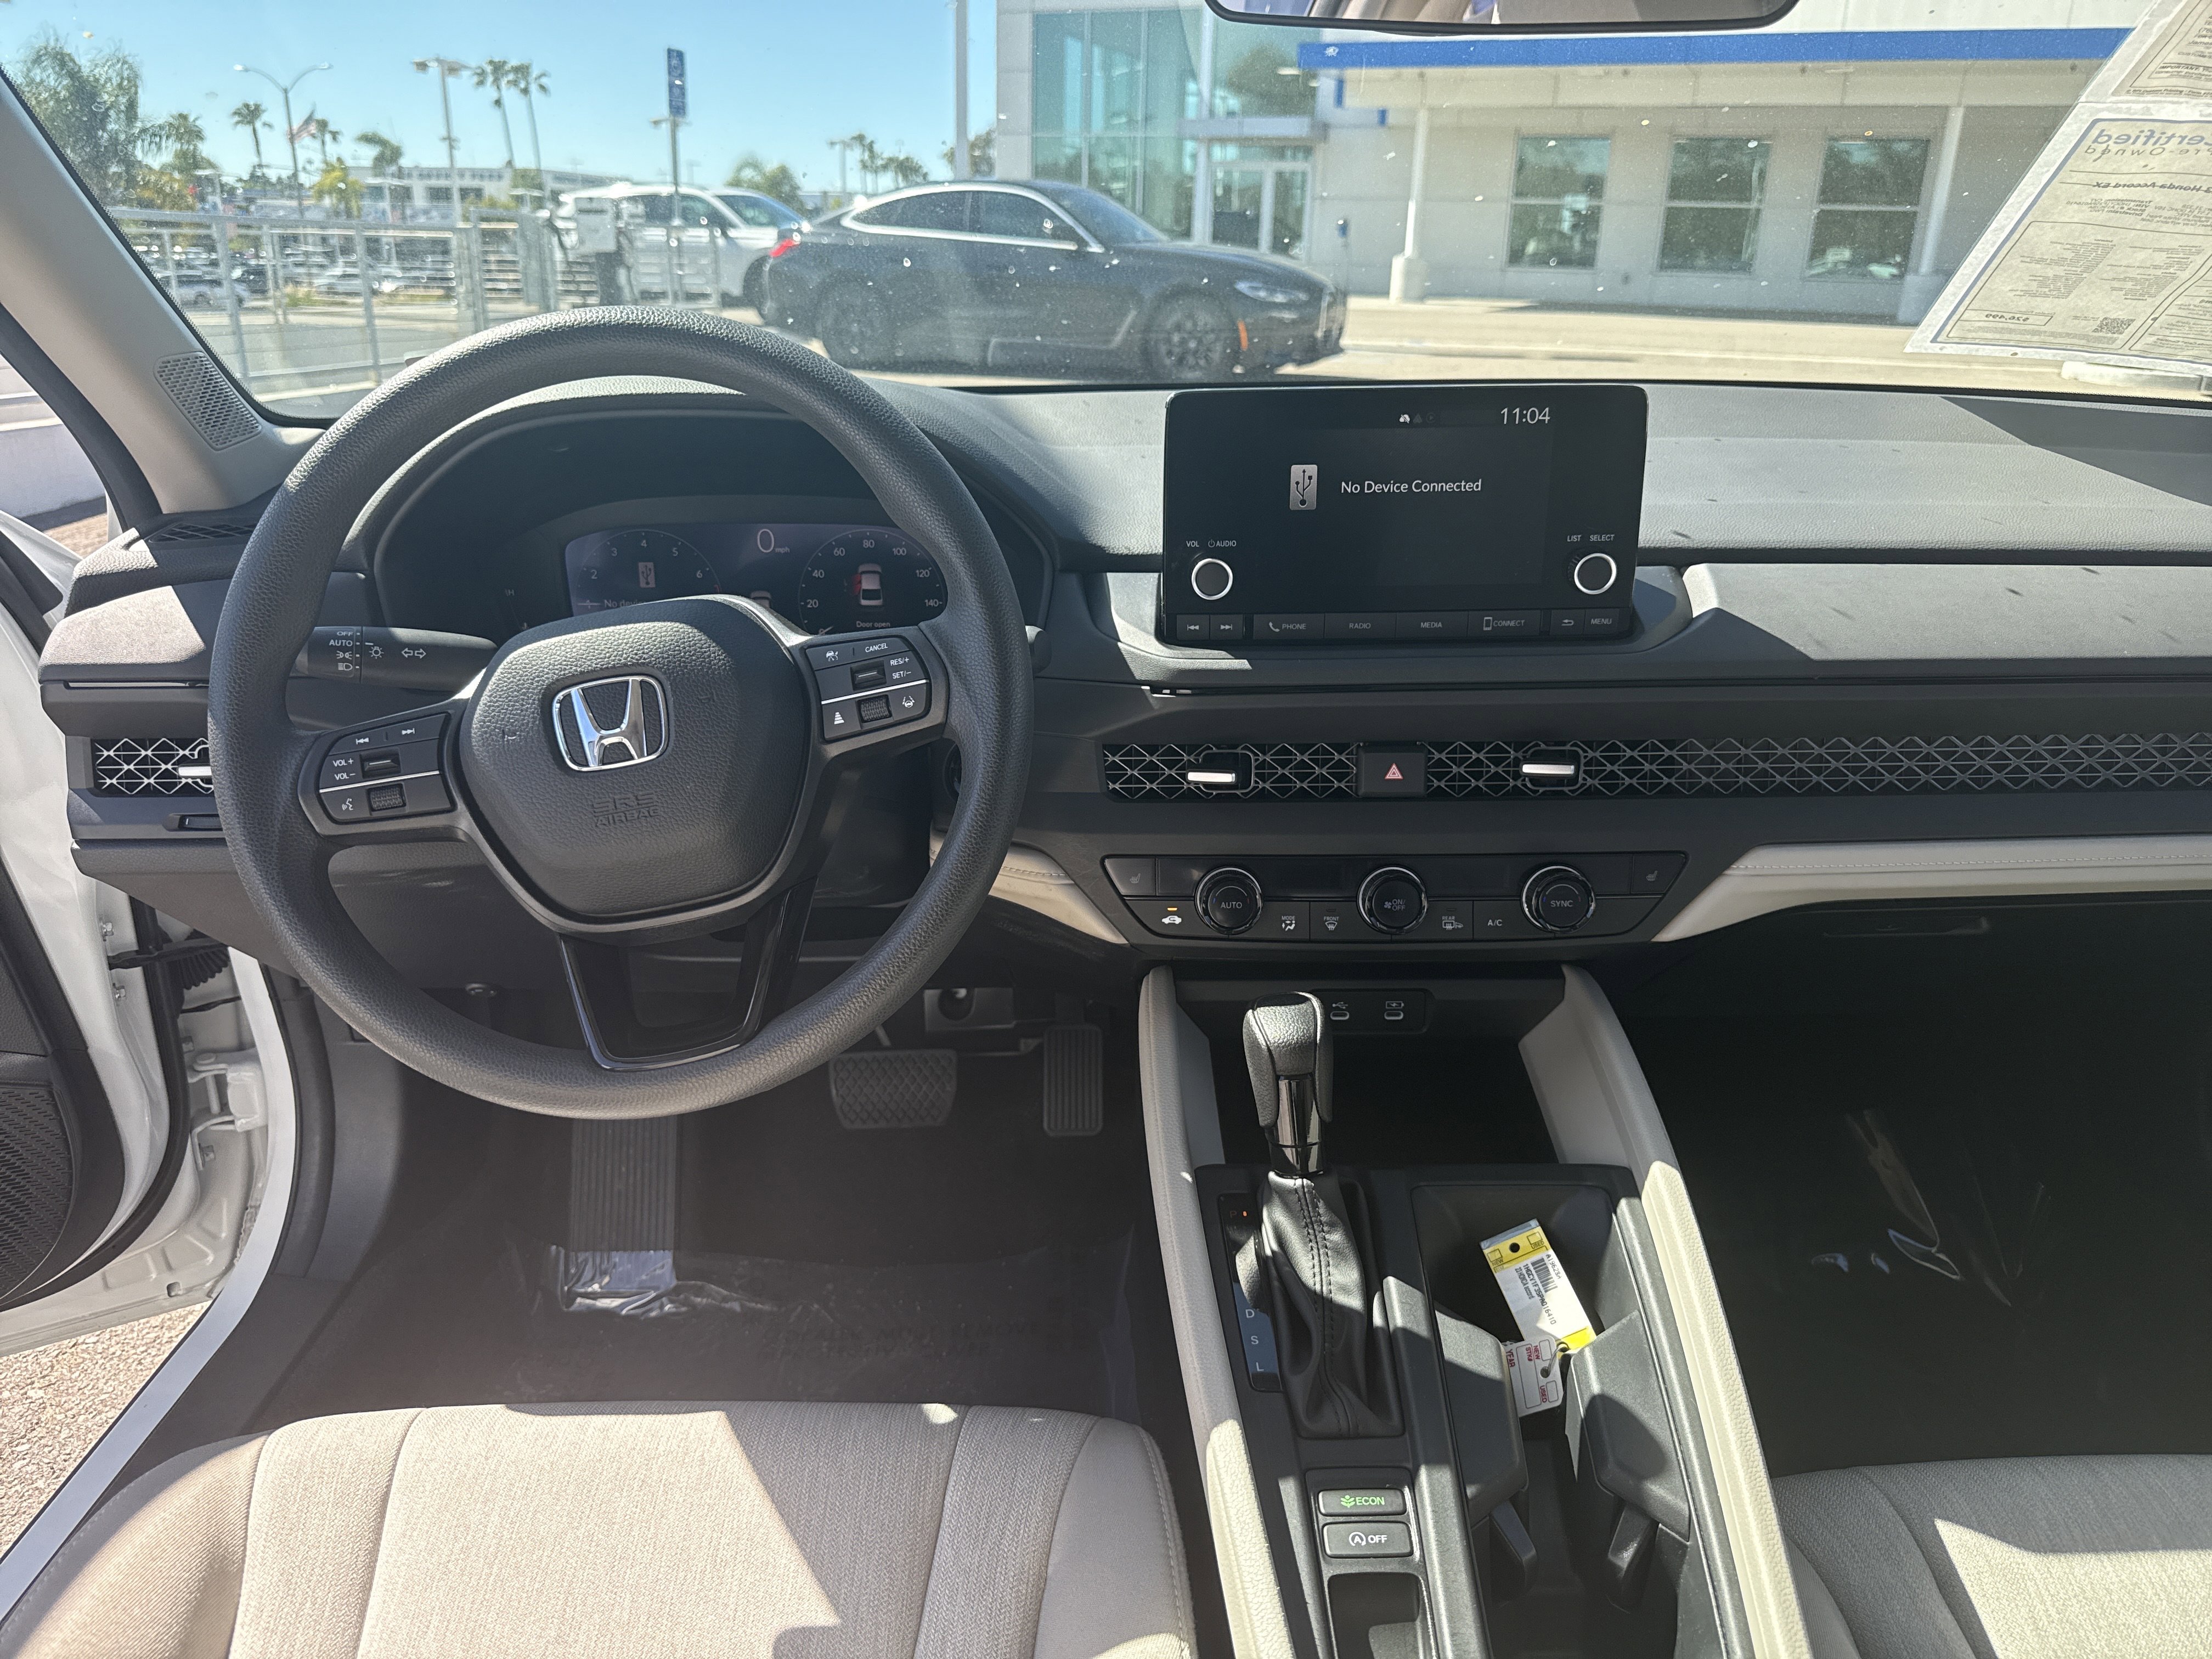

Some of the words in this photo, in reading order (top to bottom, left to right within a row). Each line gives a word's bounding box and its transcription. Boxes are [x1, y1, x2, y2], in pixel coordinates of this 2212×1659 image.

[1500, 407, 1551, 425] 11:04
[1341, 481, 1360, 494] No
[1365, 480, 1409, 493] Device
[1412, 478, 1482, 493] Connected
[640, 539, 647, 548] 4
[757, 528, 775, 553] 0
[862, 539, 875, 548] 80
[611, 548, 618, 557] 3
[672, 548, 679, 557] 5
[833, 548, 845, 556] 60
[893, 548, 907, 556] 100
[591, 569, 598, 579] 2
[696, 570, 703, 579] 6
[812, 569, 825, 578] 40
[916, 569, 930, 578] 120
[806, 599, 819, 608] 20
[1493, 619, 1525, 628] CONNECT
[1590, 617, 1613, 626] MENU
[1282, 623, 1307, 631] PHONE
[865, 642, 888, 653] CANCEL
[890, 657, 910, 666] RES/+
[1220, 901, 1243, 910] AUTO
[1550, 899, 1573, 908] SYNC
[1487, 918, 1503, 927] A/C
[1531, 1240, 1545, 1249] USED
[1245, 1309, 1255, 1318] D
[1251, 1335, 1259, 1345] S
[1505, 1348, 1515, 1368] YEAR
[1256, 1362, 1264, 1372] L
[1356, 1497, 1385, 1505] ECON
[1368, 1534, 1387, 1543] OFF
